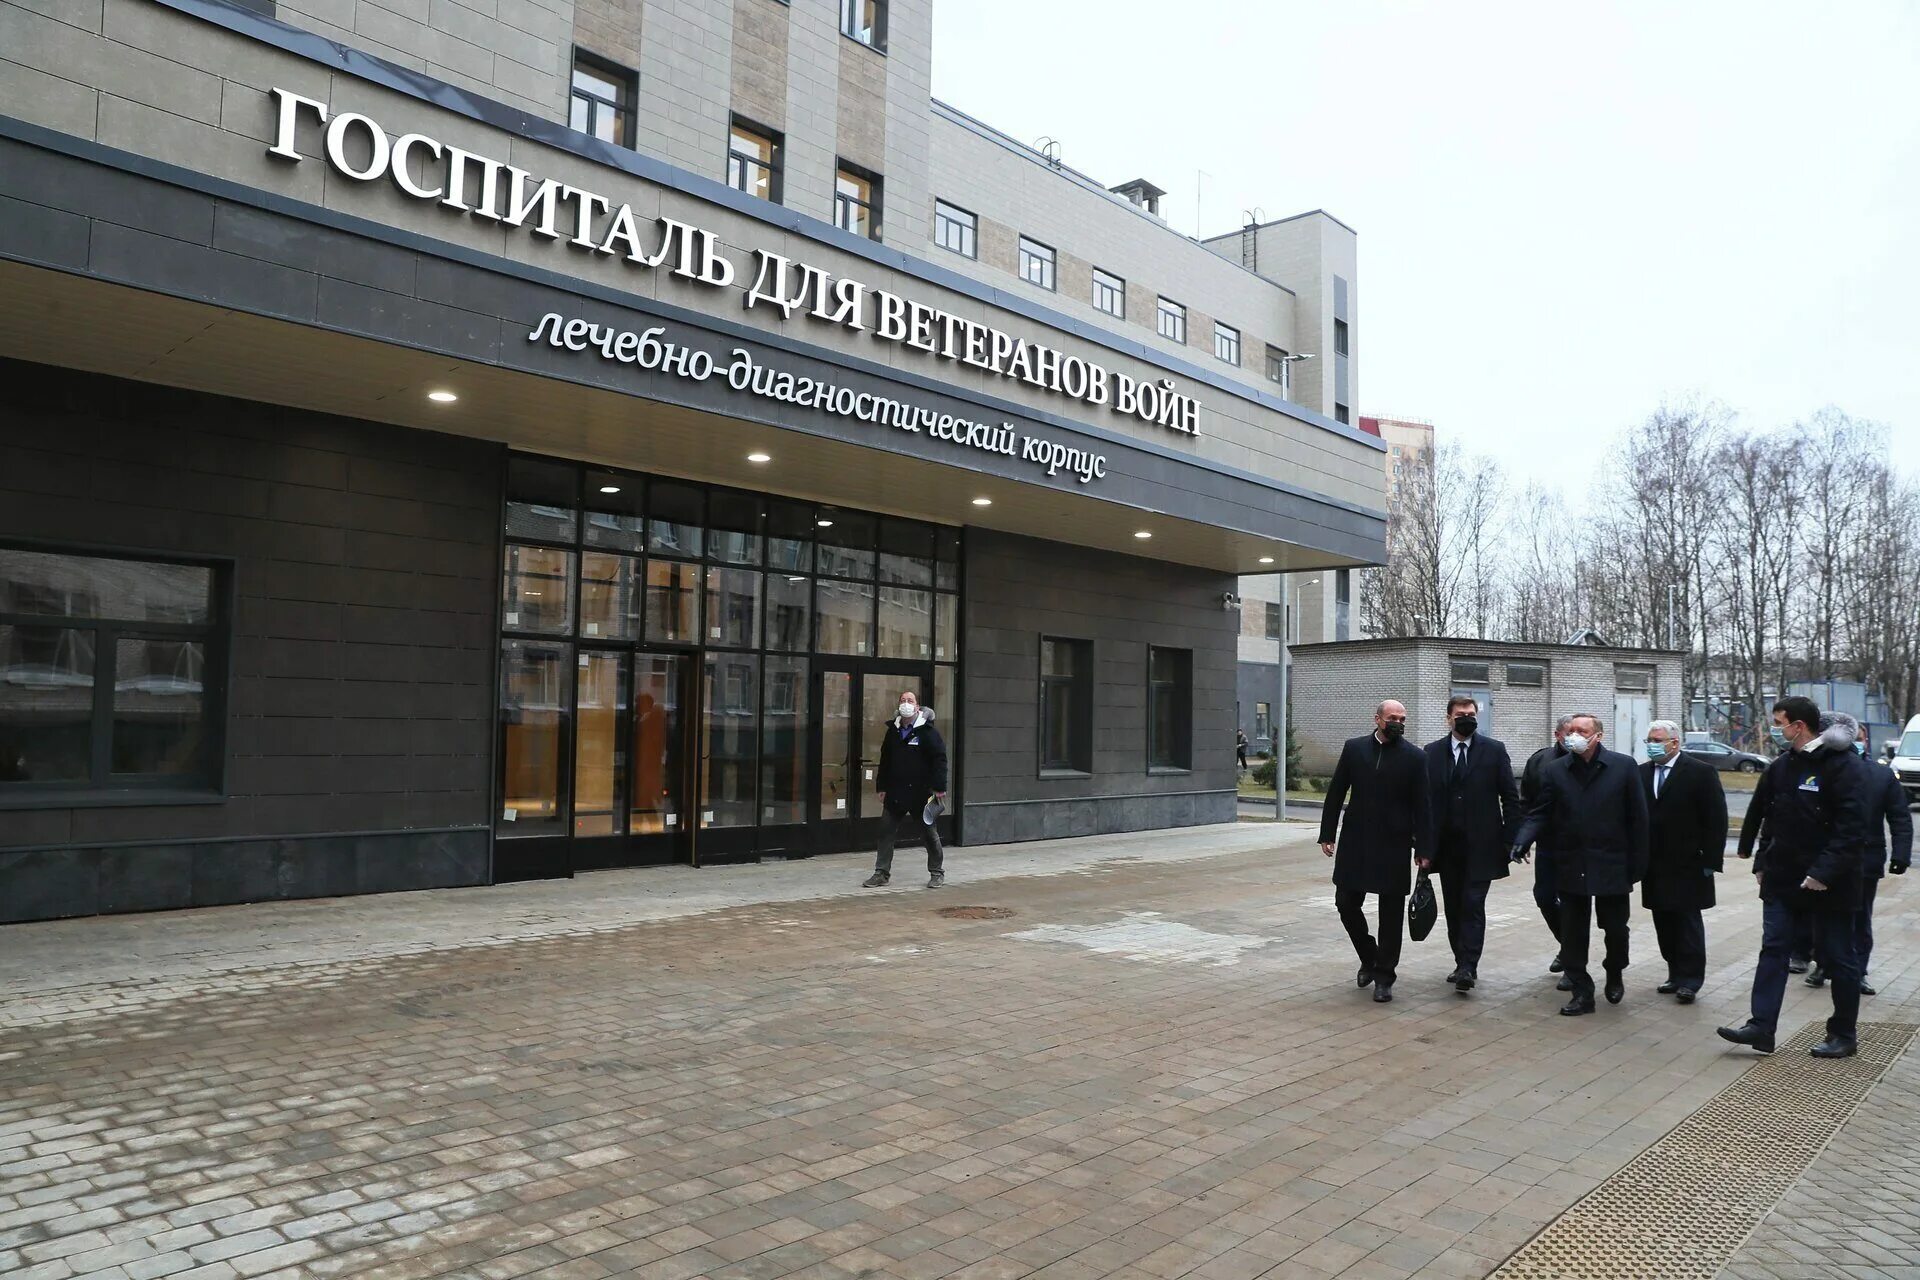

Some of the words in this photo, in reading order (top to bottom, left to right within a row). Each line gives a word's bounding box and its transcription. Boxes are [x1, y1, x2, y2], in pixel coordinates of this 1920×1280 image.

[266, 87, 735, 288] ГОСПИТАЛЬ
[745, 248, 866, 332] ДЛЯ
[876, 290, 1109, 406] ВЕТЕРАНОВ
[1116, 372, 1203, 437] ВОЙН
[528, 312, 1017, 456] лечебно-диагностический
[1021, 435, 1107, 485] корпус
